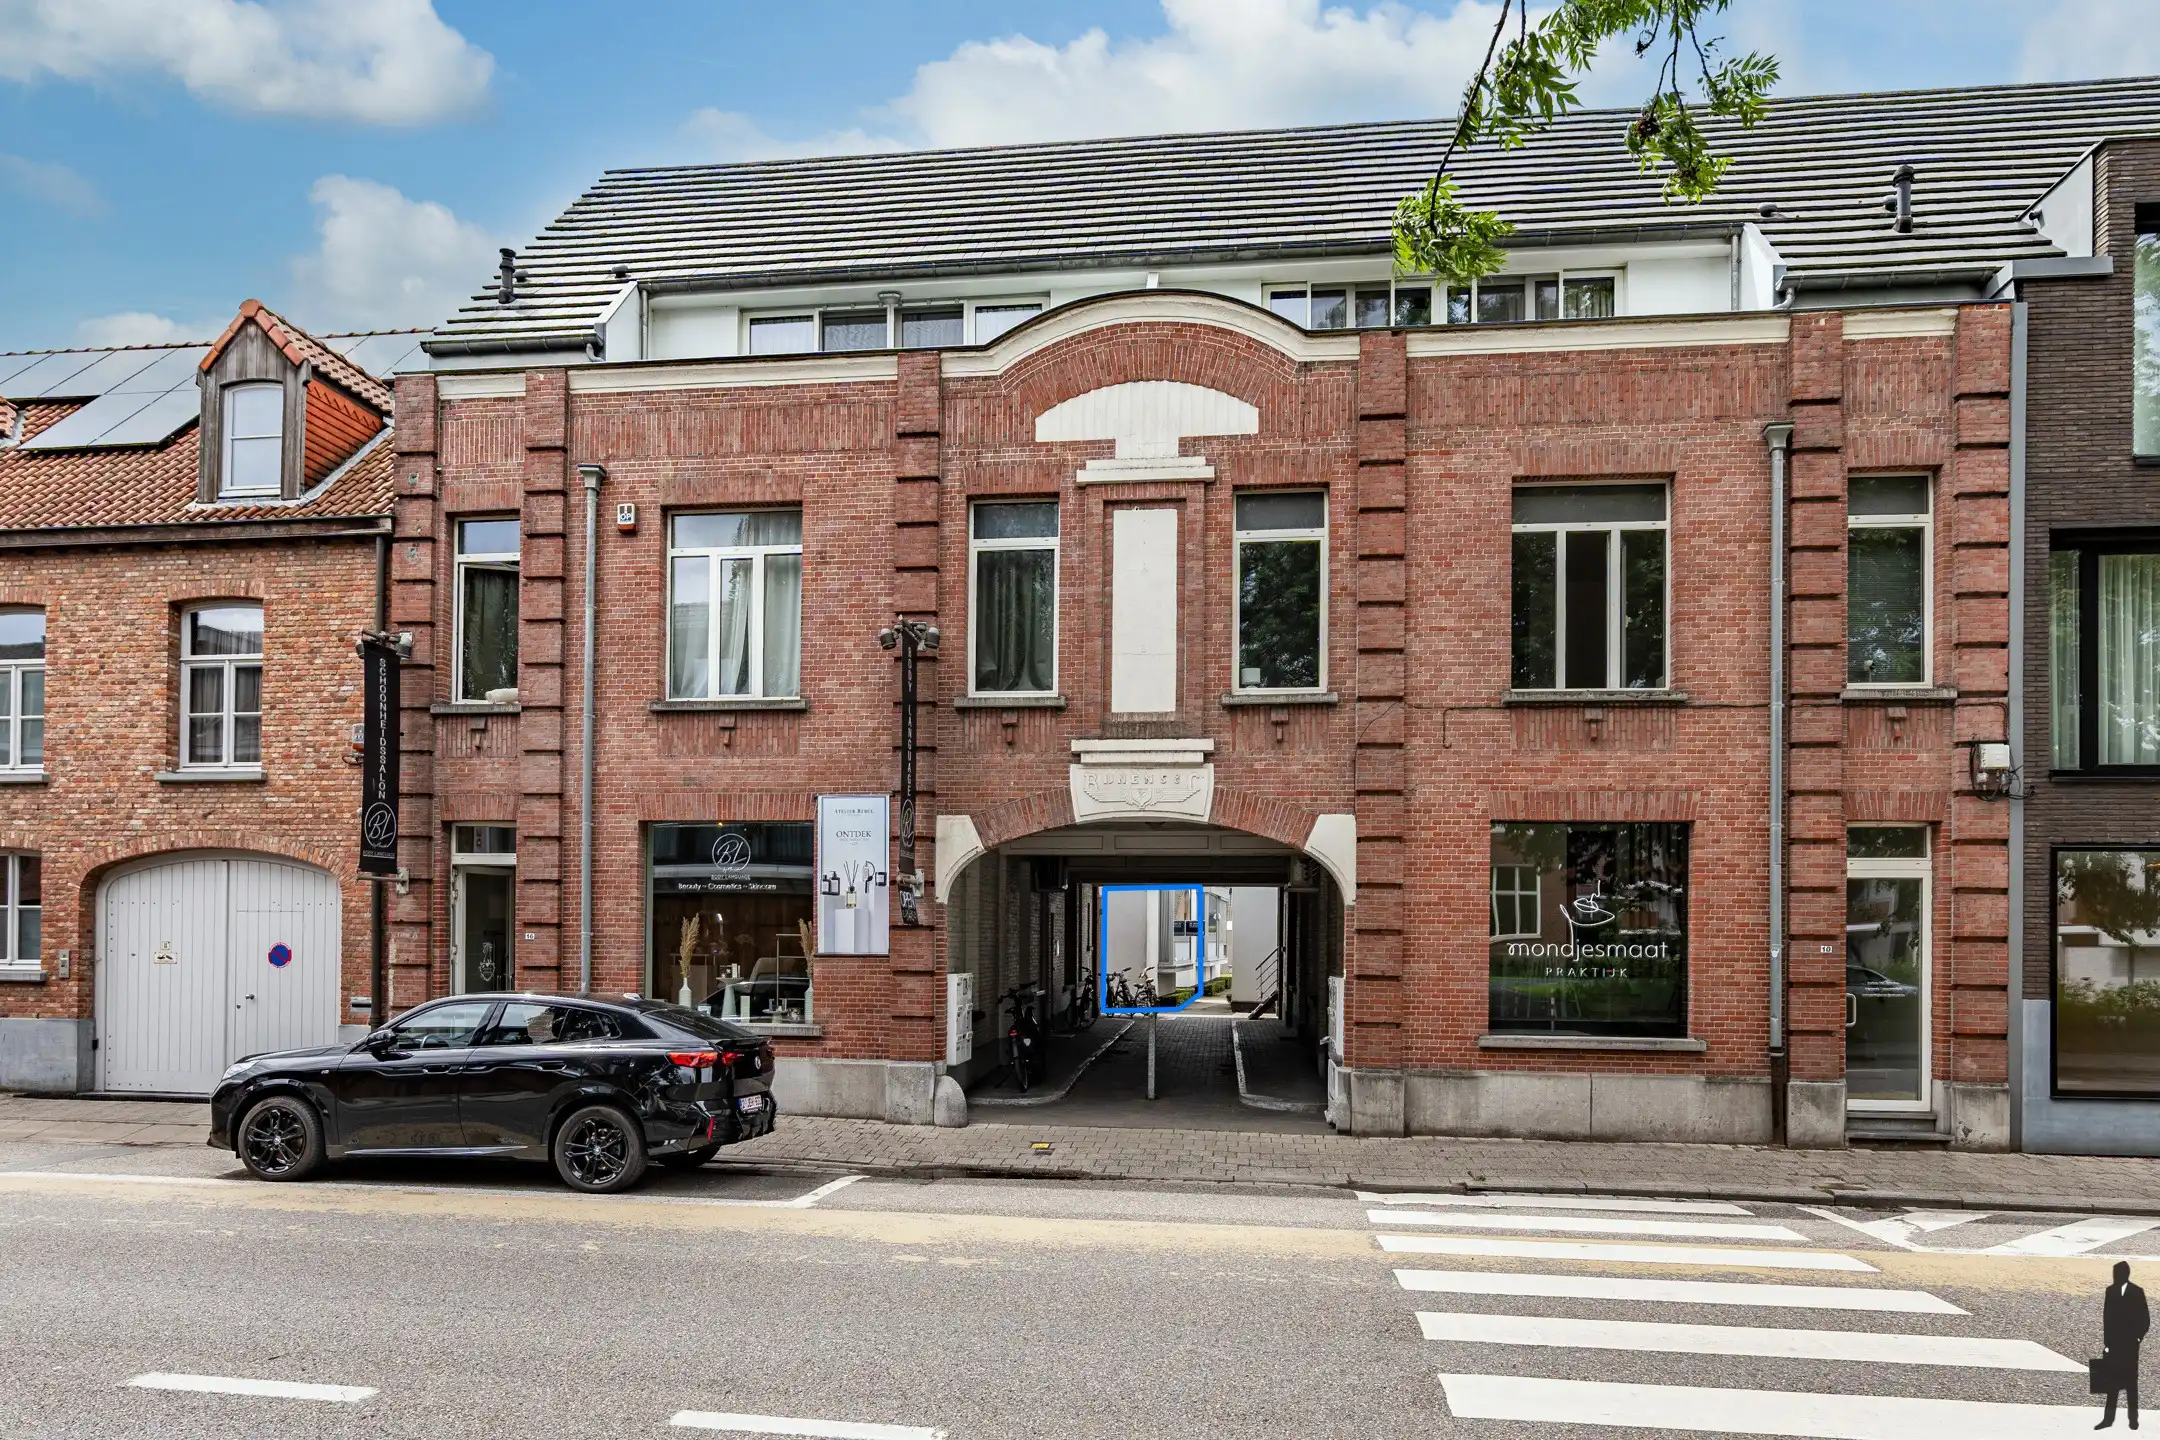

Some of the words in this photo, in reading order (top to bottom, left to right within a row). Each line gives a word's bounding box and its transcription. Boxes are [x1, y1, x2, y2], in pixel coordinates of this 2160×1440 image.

[379, 658, 387, 800] SCHOONHEIDSSALON
[368, 810, 393, 840] BL
[835, 830, 872, 838] ONTDEK
[716, 839, 747, 865] BL
[678, 883, 702, 892] Beauty
[707, 883, 742, 891] Cosmetics
[748, 883, 777, 891] Skincare
[1506, 938, 1669, 962] mondjesmaat
[1545, 967, 1628, 978] PRAKTIJK
